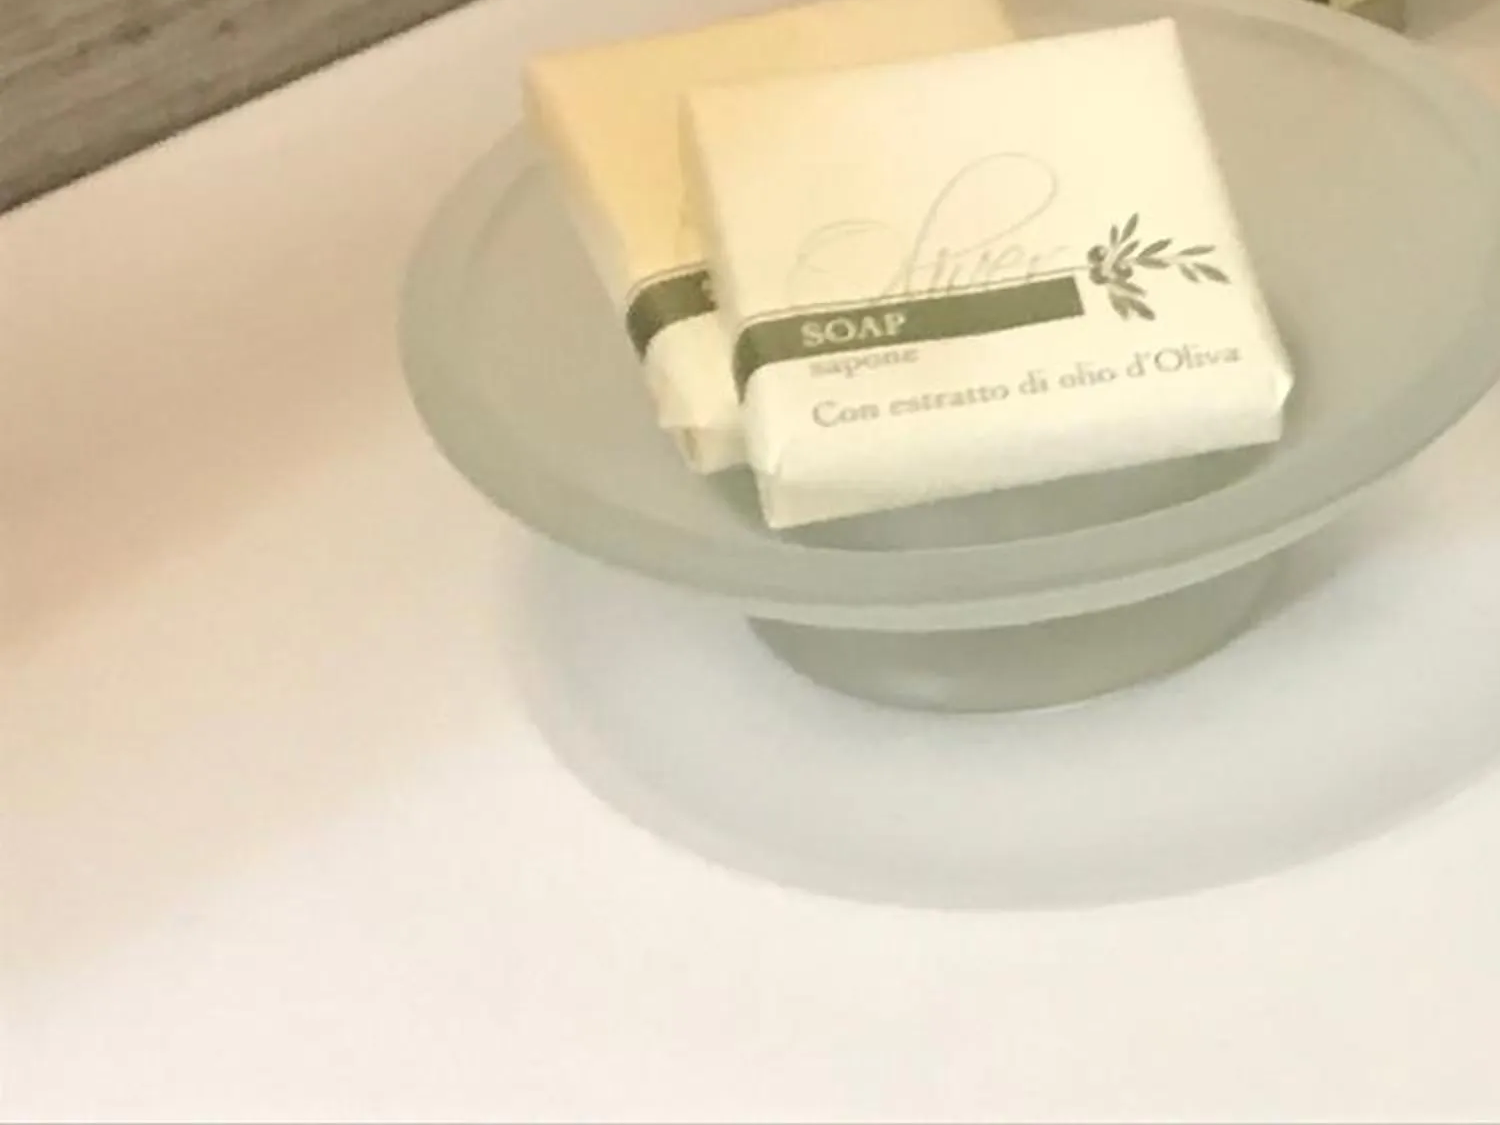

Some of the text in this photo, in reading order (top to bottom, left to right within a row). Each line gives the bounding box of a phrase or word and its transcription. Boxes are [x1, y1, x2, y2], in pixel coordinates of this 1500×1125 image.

[801, 312, 907, 348] SOAP
[808, 347, 920, 379] sapone
[812, 342, 1243, 428] Con estratto di olio d'Oliva
